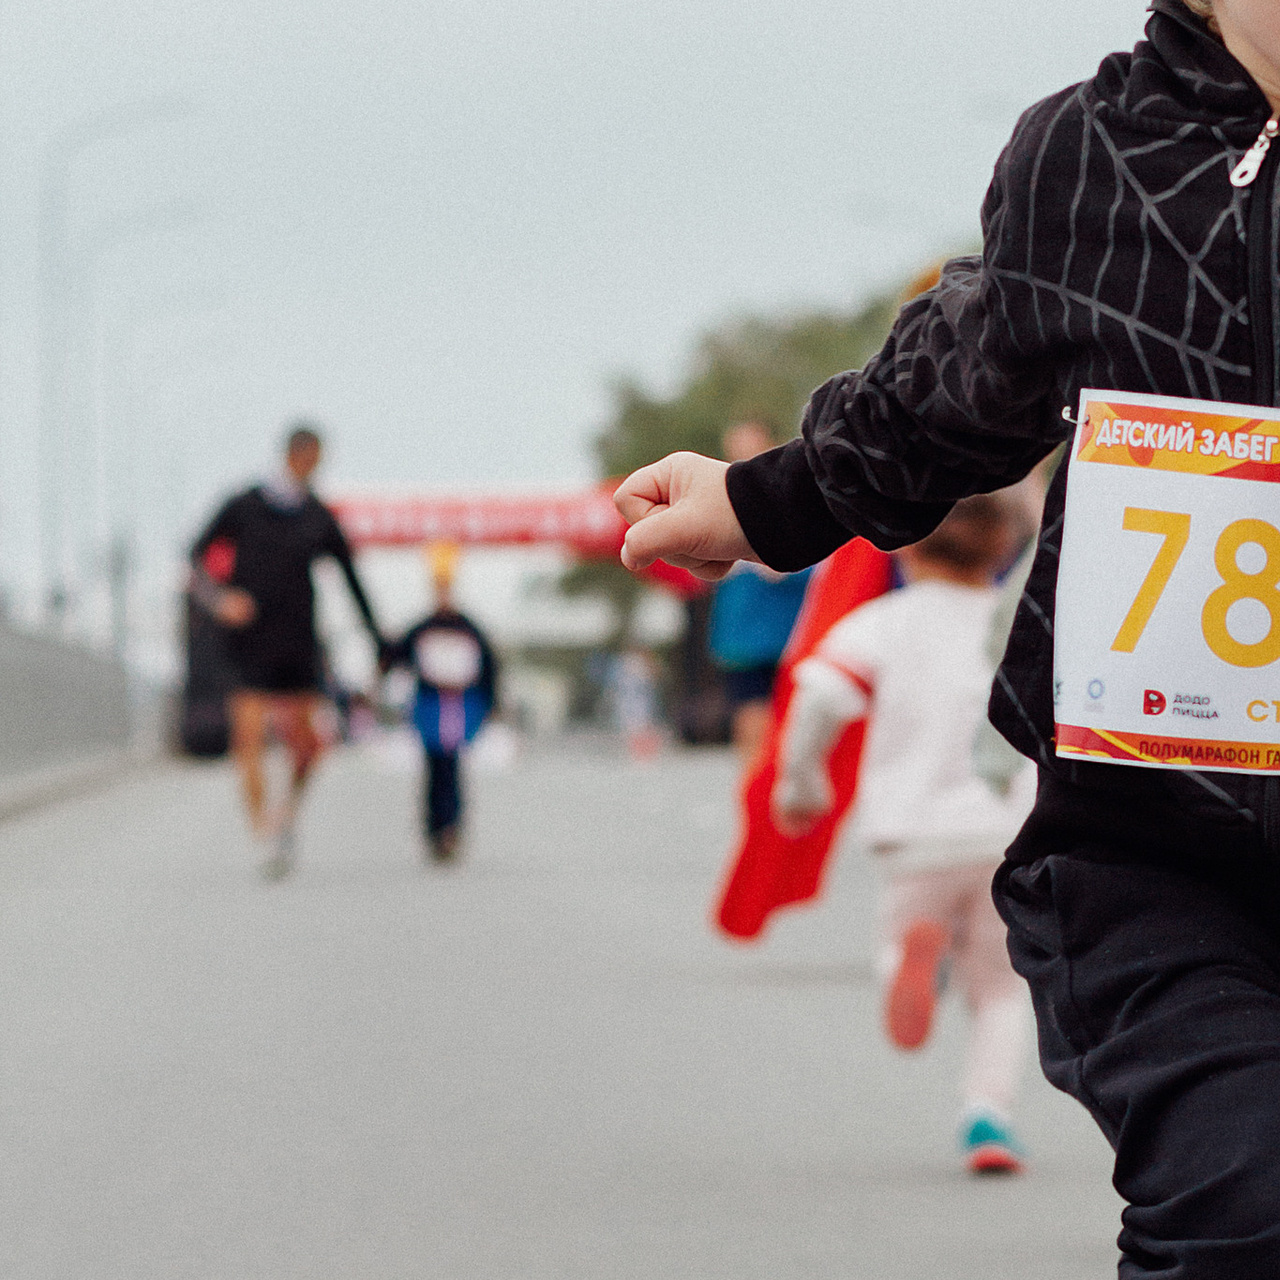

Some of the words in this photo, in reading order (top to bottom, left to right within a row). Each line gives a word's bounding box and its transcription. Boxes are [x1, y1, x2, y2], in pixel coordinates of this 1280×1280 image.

[1096, 419, 1195, 453] ДЕТСКИЙ
[1199, 428, 1279, 462] ЗАБЕГ
[1173, 694, 1211, 706] ДОДО
[1172, 707, 1219, 719] ПИЦЦА
[1138, 740, 1260, 764] ПОЛУМАРАФОН
